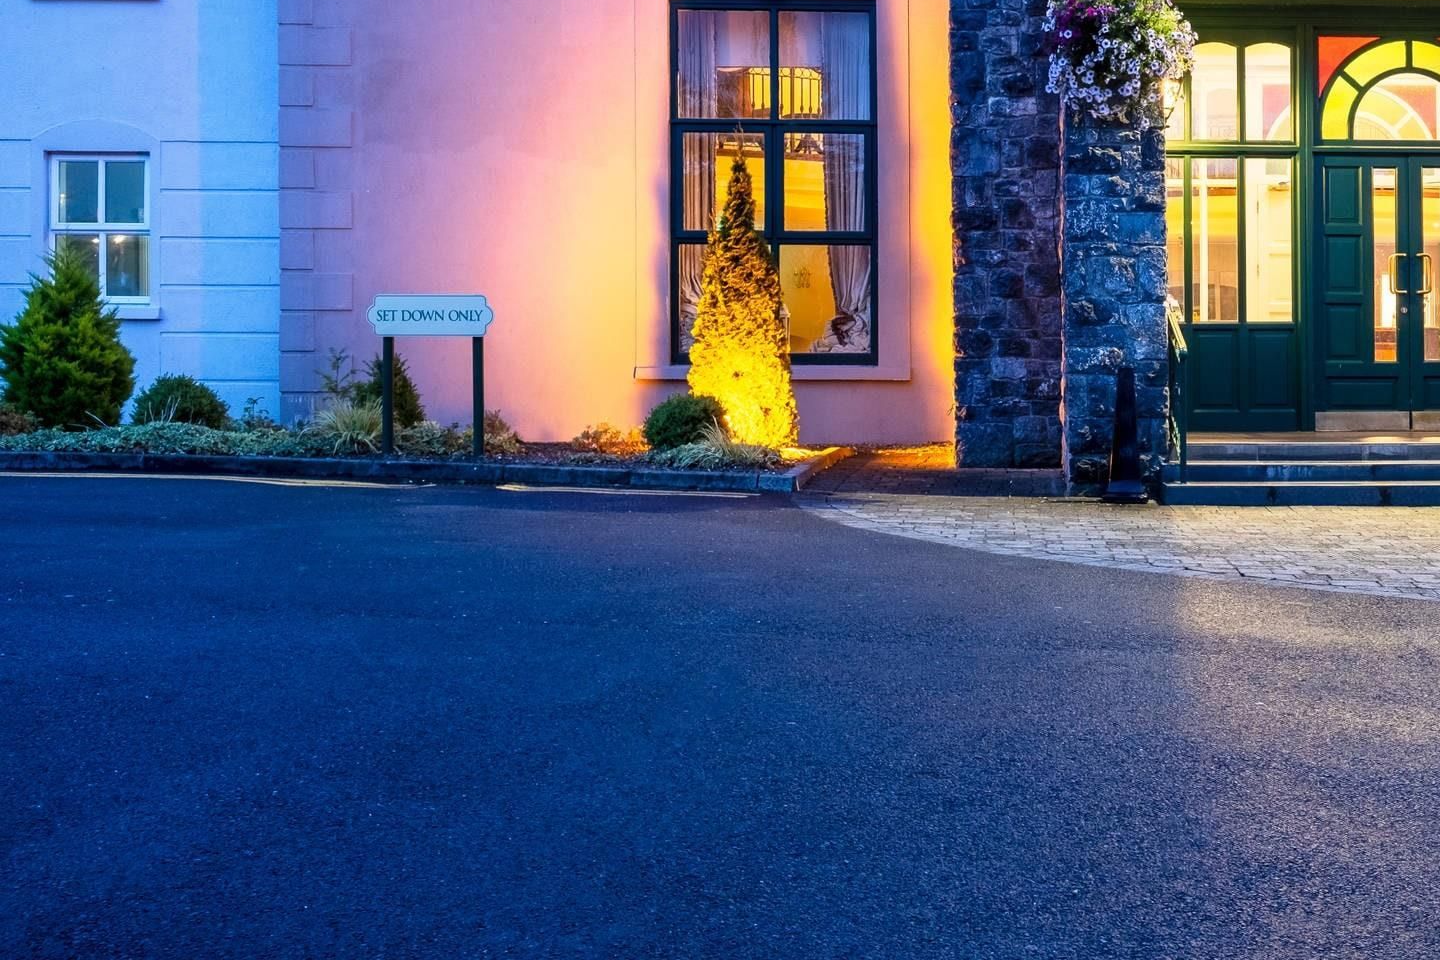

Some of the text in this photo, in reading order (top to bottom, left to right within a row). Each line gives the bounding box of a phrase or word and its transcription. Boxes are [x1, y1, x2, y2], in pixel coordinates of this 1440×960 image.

[376, 309, 483, 322] SET DOWN ONLY
